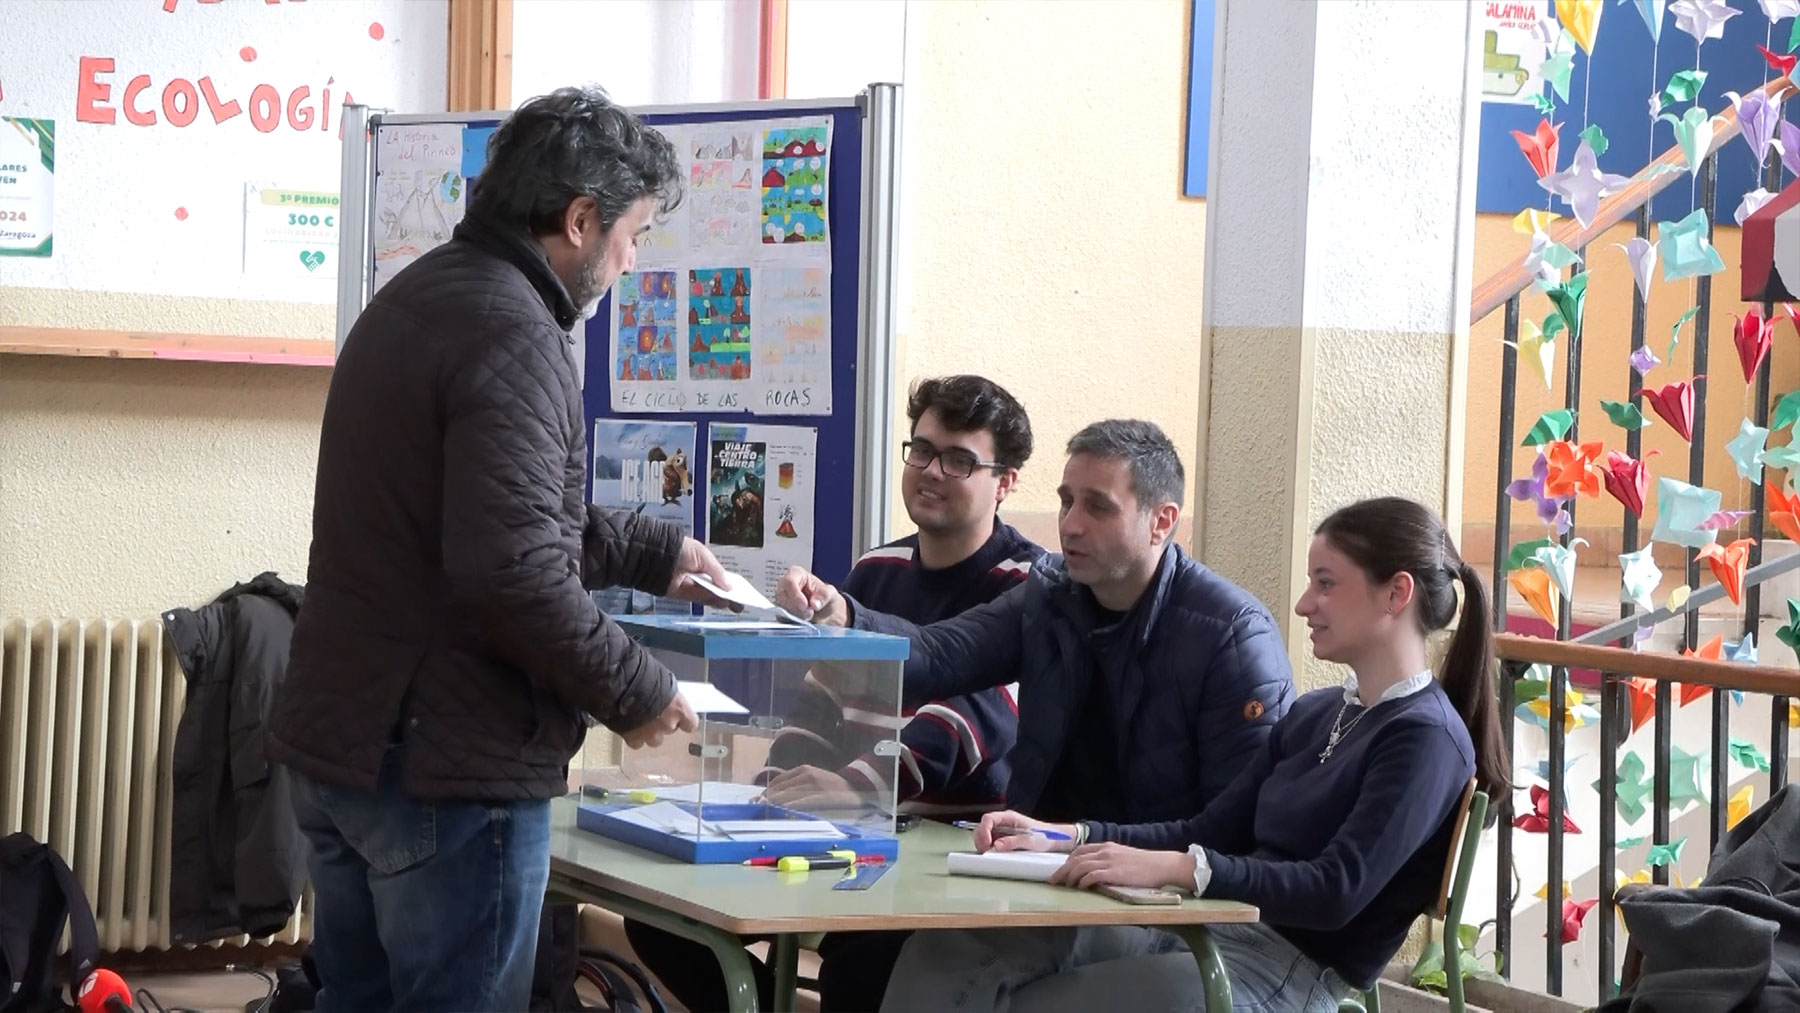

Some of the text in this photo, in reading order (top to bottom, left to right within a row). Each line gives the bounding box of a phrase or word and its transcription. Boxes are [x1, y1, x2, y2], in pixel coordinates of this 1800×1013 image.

[294, 194, 340, 206] PREMIO
[288, 213, 320, 227] 300
[622, 387, 812, 407] EL CICLO DE LAS ROCAS
[724, 442, 752, 454] VIAJE
[718, 449, 758, 460] CENTRO
[720, 459, 755, 469] TIERRA
[621, 459, 666, 504] ICE AGE
